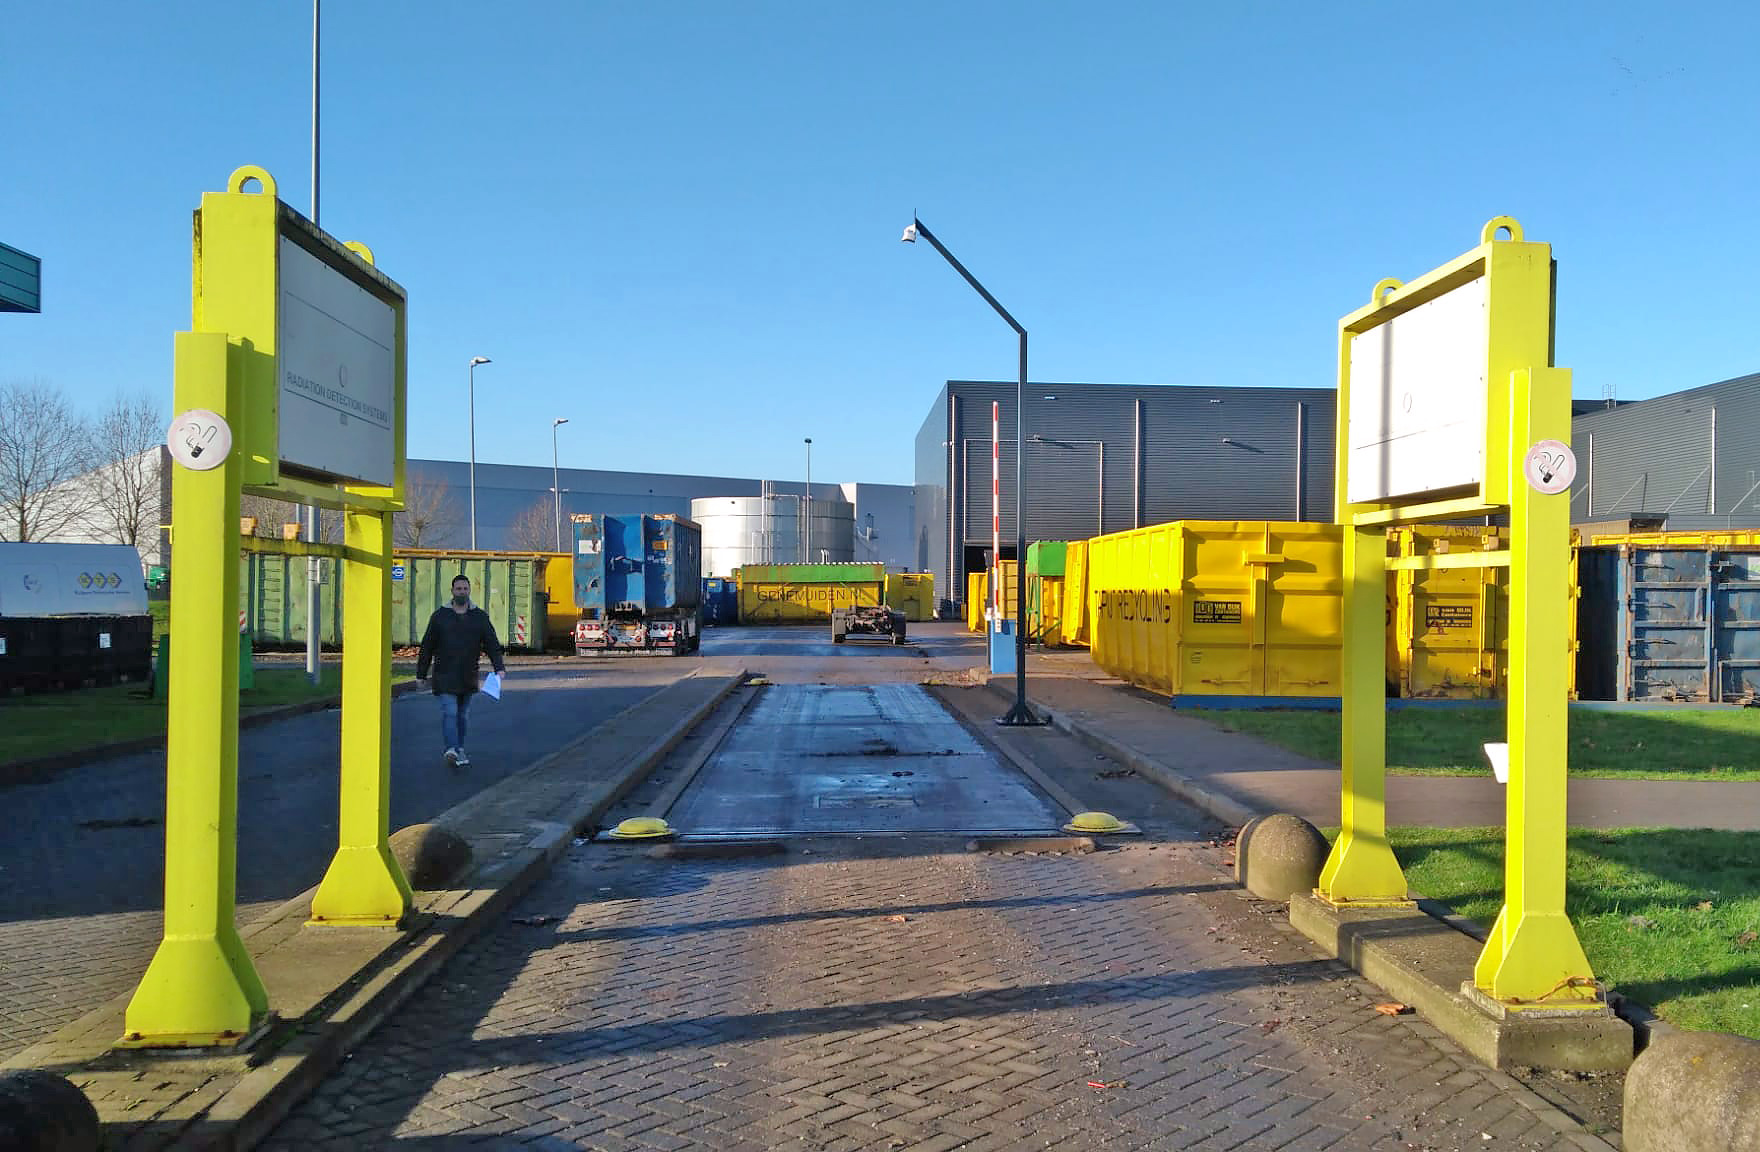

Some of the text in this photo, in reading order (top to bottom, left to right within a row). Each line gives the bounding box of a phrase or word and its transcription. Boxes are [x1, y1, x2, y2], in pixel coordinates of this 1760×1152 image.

[287, 371, 325, 398] RADIATION
[327, 388, 361, 411] DETECTION
[363, 402, 388, 422] SYSTEMS
